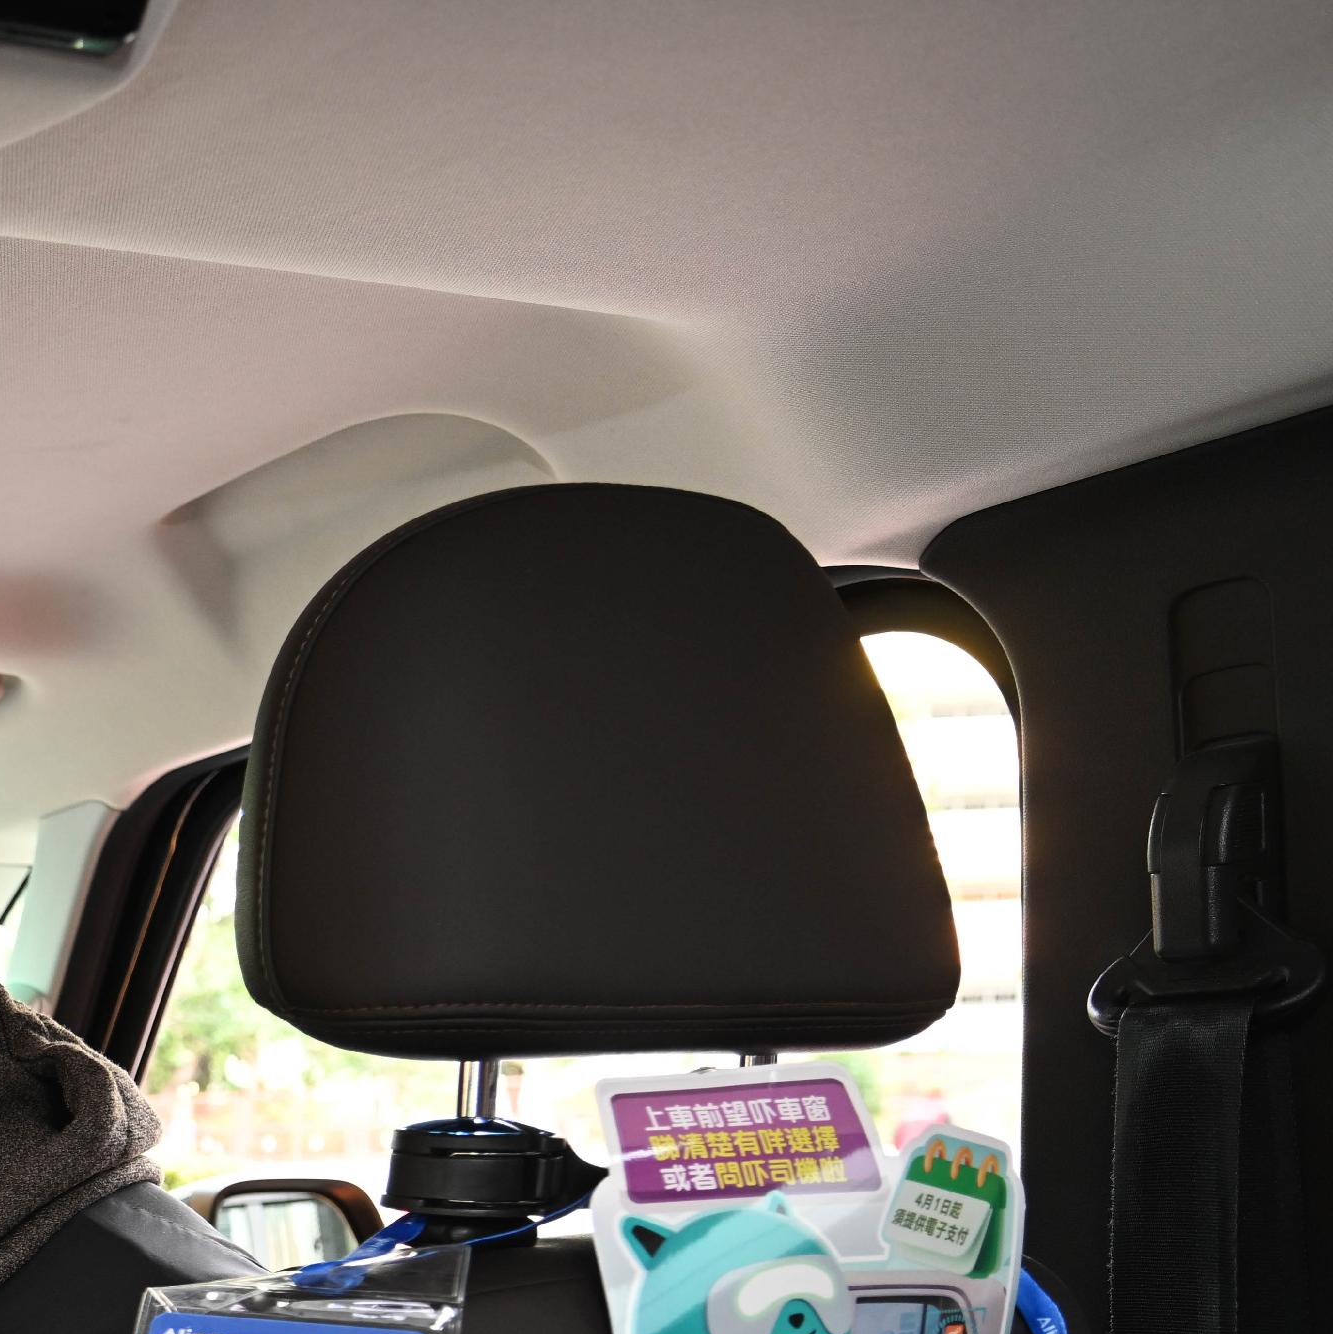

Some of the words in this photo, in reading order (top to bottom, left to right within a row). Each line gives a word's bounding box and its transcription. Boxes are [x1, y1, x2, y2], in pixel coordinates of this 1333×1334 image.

[645, 1095, 831, 1131] 上車前望吓車窗
[659, 1156, 848, 1192] 或者問吓司機啦
[915, 1193, 963, 1219] 4月1日起
[891, 1208, 969, 1246] 須提供電子支付
